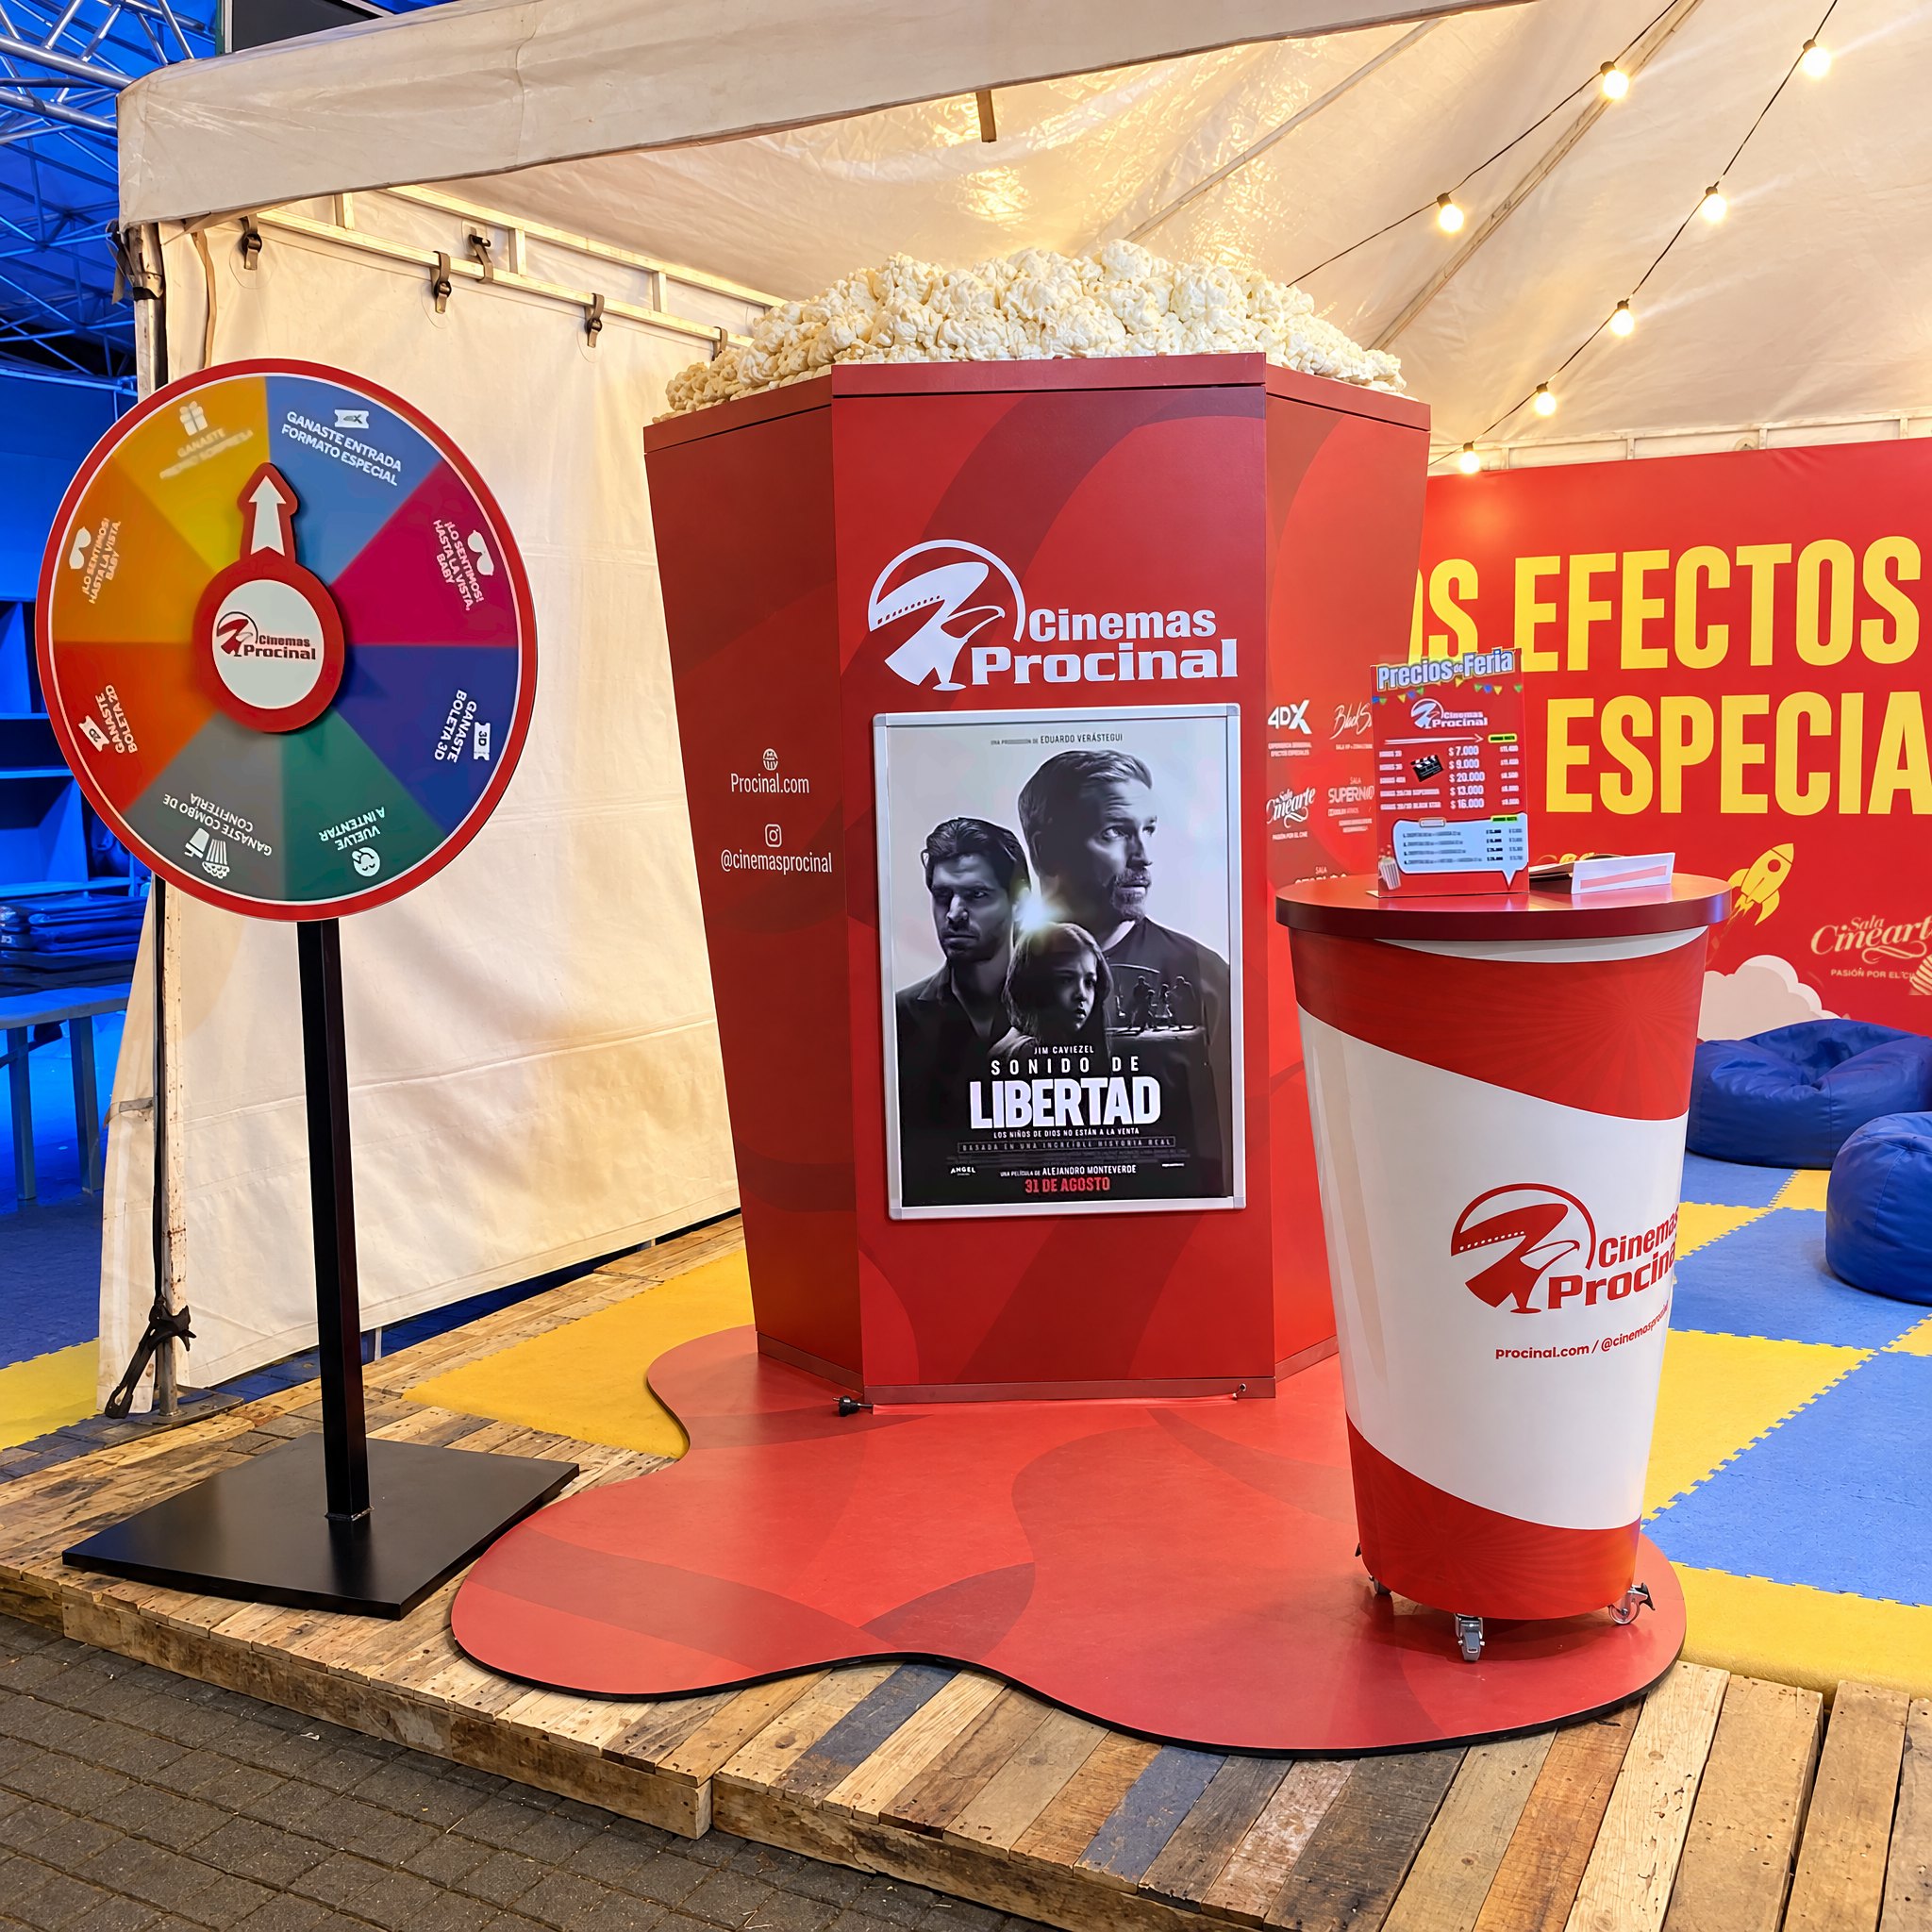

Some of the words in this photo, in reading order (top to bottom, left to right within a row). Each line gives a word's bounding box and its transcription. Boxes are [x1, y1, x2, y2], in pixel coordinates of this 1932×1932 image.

[287, 411, 344, 445] GANASTE
[344, 438, 401, 472] ENTRADA
[281, 424, 340, 458] FORMATO
[341, 452, 397, 486] ESPECIAL
[106, 551, 119, 580] BABY
[433, 520, 454, 558] HASTA
[449, 558, 460, 575] LA
[456, 574, 474, 610] VISTA,
[437, 553, 455, 583] BABY
[444, 522, 459, 541] ¡LO
[455, 541, 484, 602] SENTIMOS!
[89, 570, 105, 604] HASTA
[100, 555, 110, 568] LA
[1514, 536, 1922, 672] EFECTOS
[1029, 608, 1217, 641] Cinemas
[243, 644, 316, 659] Procinal
[259, 635, 310, 647] Cinemas
[972, 639, 1238, 685] Procinal
[1377, 659, 1453, 691] Precios
[1464, 649, 1513, 677] Feria
[106, 685, 119, 703] 2D
[95, 692, 125, 753] GANASTE
[113, 702, 138, 753] BOLETA
[441, 690, 468, 740] BOLETA
[1267, 699, 1313, 734] 4DX
[1432, 717, 1488, 728] Procinal
[447, 701, 477, 763] GANASTE
[478, 731, 487, 746] 3D
[1040, 735, 1075, 744] EDUARDO
[1077, 732, 1123, 742] VERÁSTEGUI
[434, 741, 447, 760] 3D
[1455, 745, 1479, 757] 7.000
[1456, 758, 1479, 769] 9.000
[1545, 691, 1932, 816] ESPECIA
[730, 773, 809, 793] Procinal.com
[1457, 772, 1485, 782] 20.000
[1457, 785, 1484, 795] 13.000
[163, 794, 178, 809] DE
[191, 792, 253, 832] CONFITERÍA
[375, 807, 385, 818] A
[179, 803, 221, 830] COMBO
[319, 811, 376, 841] INTENTAR
[221, 824, 272, 857] GANASTE
[334, 825, 381, 851] VUELVE
[721, 849, 832, 875] @cinemasprocinal
[1811, 915, 1932, 956] Cineart
[1848, 915, 1885, 932] Sala
[1830, 968, 1864, 977] PASIÓN
[1052, 1045, 1094, 1054] CAVIEZEL
[991, 1058, 1090, 1075] SONIDO
[1112, 1056, 1139, 1072] DE
[970, 1076, 1160, 1129] LIBERTAD
[1009, 1129, 1030, 1138] NIÑOS
[1075, 1127, 1096, 1136] ESTÁN
[1042, 1166, 1085, 1175] ALEJANDRO
[1087, 1164, 1137, 1174] MONTEVERDE
[1024, 1179, 1039, 1193] 31
[1042, 1178, 1058, 1192] DE
[1060, 1176, 1110, 1191] AGOSTO
[1548, 1240, 1675, 1309] Procina
[1495, 1341, 1590, 1359] procinal.com
[1591, 1340, 1599, 1354] /
